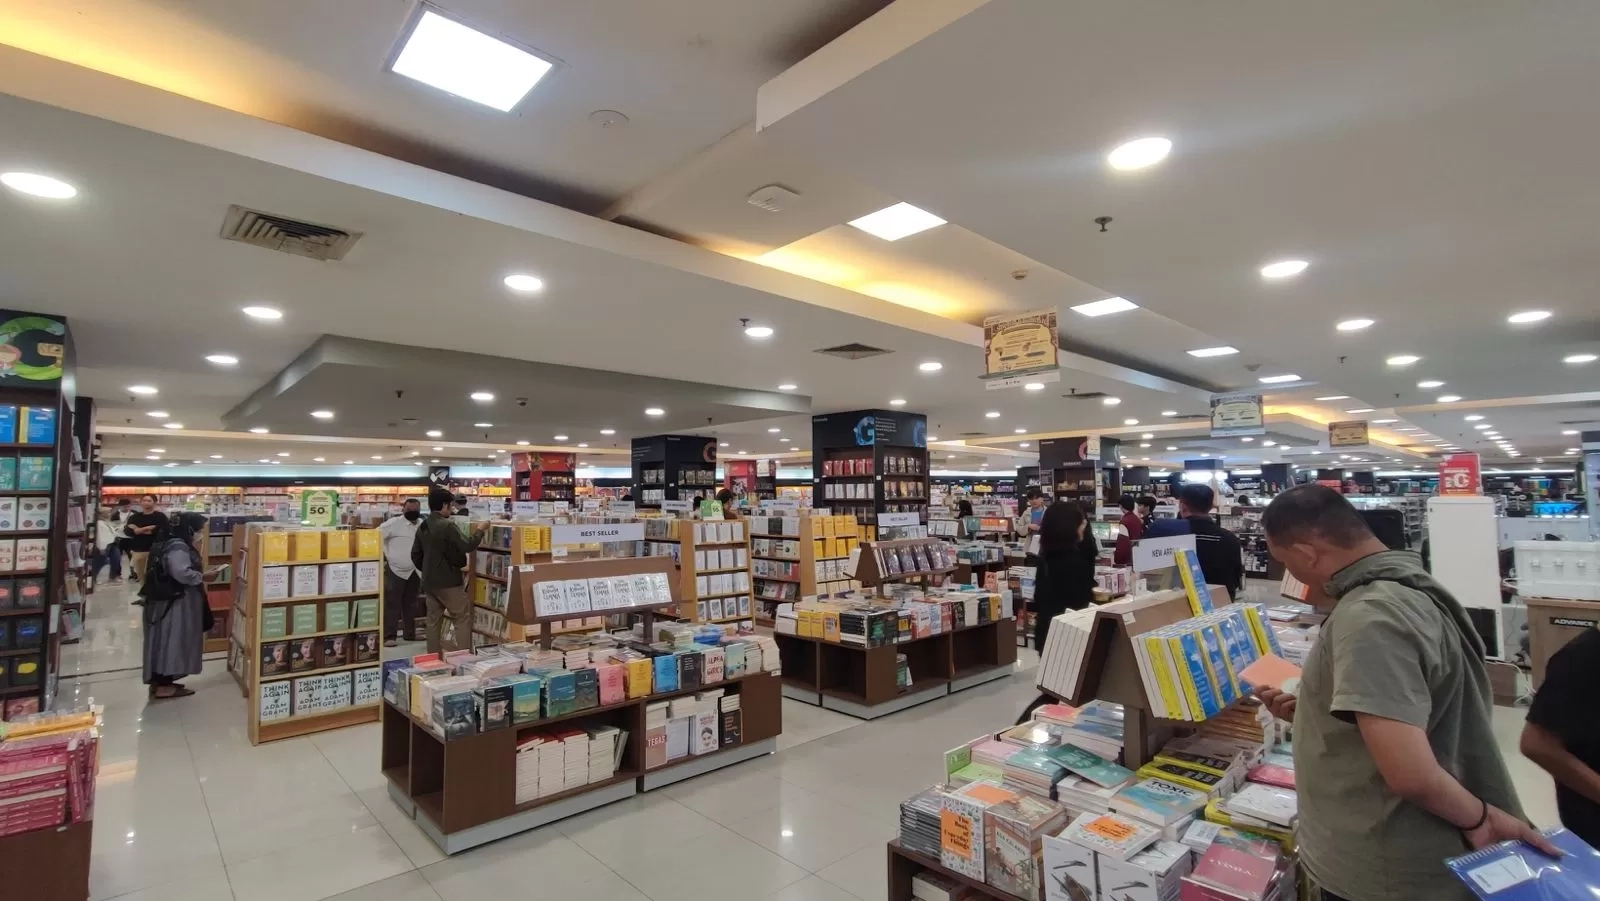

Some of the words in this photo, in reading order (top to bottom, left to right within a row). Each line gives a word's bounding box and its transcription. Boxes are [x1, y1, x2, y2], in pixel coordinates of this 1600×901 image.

[1151, 549, 1163, 558] NEW
[1554, 618, 1593, 627] ADVANCE
[264, 684, 288, 692] THINK
[263, 690, 289, 698] AGAIN
[357, 693, 378, 701] GRANT
[262, 708, 287, 717] GRANT
[647, 735, 666, 747] TEGAS
[1151, 780, 1195, 797] TOXIC
